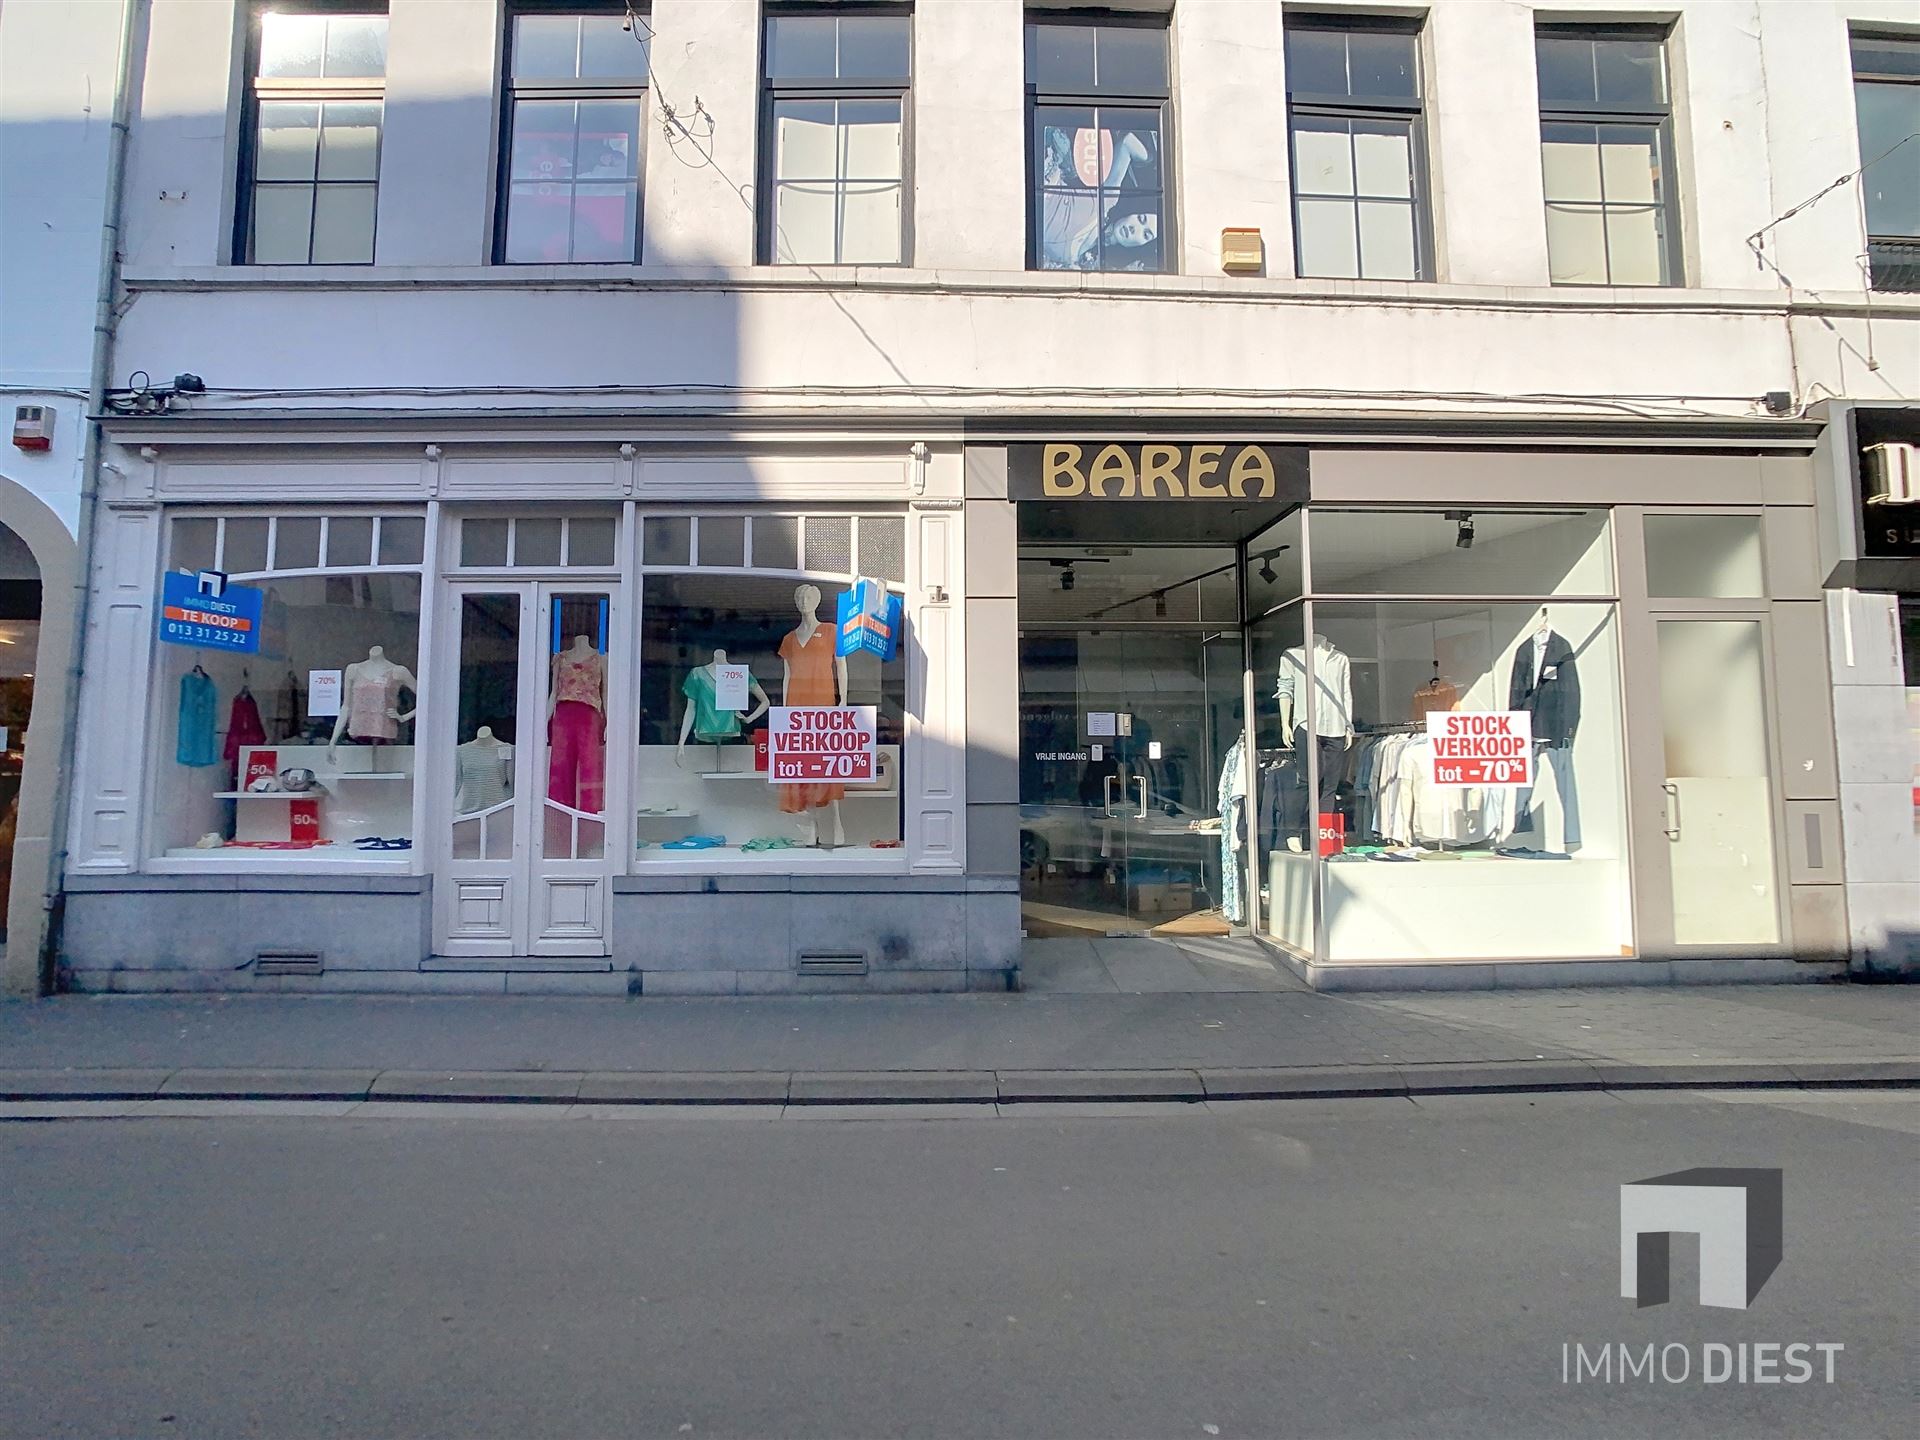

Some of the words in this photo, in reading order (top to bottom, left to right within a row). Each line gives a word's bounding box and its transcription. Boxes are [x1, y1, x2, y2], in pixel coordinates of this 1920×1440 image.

[1043, 443, 1276, 498] BAREA
[210, 601, 236, 614] DIEST
[181, 609, 198, 623] TE
[201, 612, 238, 629] KOOP
[168, 622, 192, 636] 013
[196, 627, 210, 638] 31
[214, 630, 229, 641] 25
[232, 633, 246, 644] 22
[314, 676, 337, 685] -70%
[721, 671, 744, 679] -70%
[789, 711, 857, 730] STOCK
[1446, 716, 1512, 736] STOCK
[774, 732, 871, 752] VERKOOP
[1433, 737, 1525, 757] VERKOOP
[778, 761, 803, 777] tot
[811, 754, 867, 777] -70%
[1035, 752, 1057, 761] VRIJE
[1057, 752, 1087, 761] INGANG
[1437, 766, 1463, 782] tot
[1469, 759, 1523, 782] -70%
